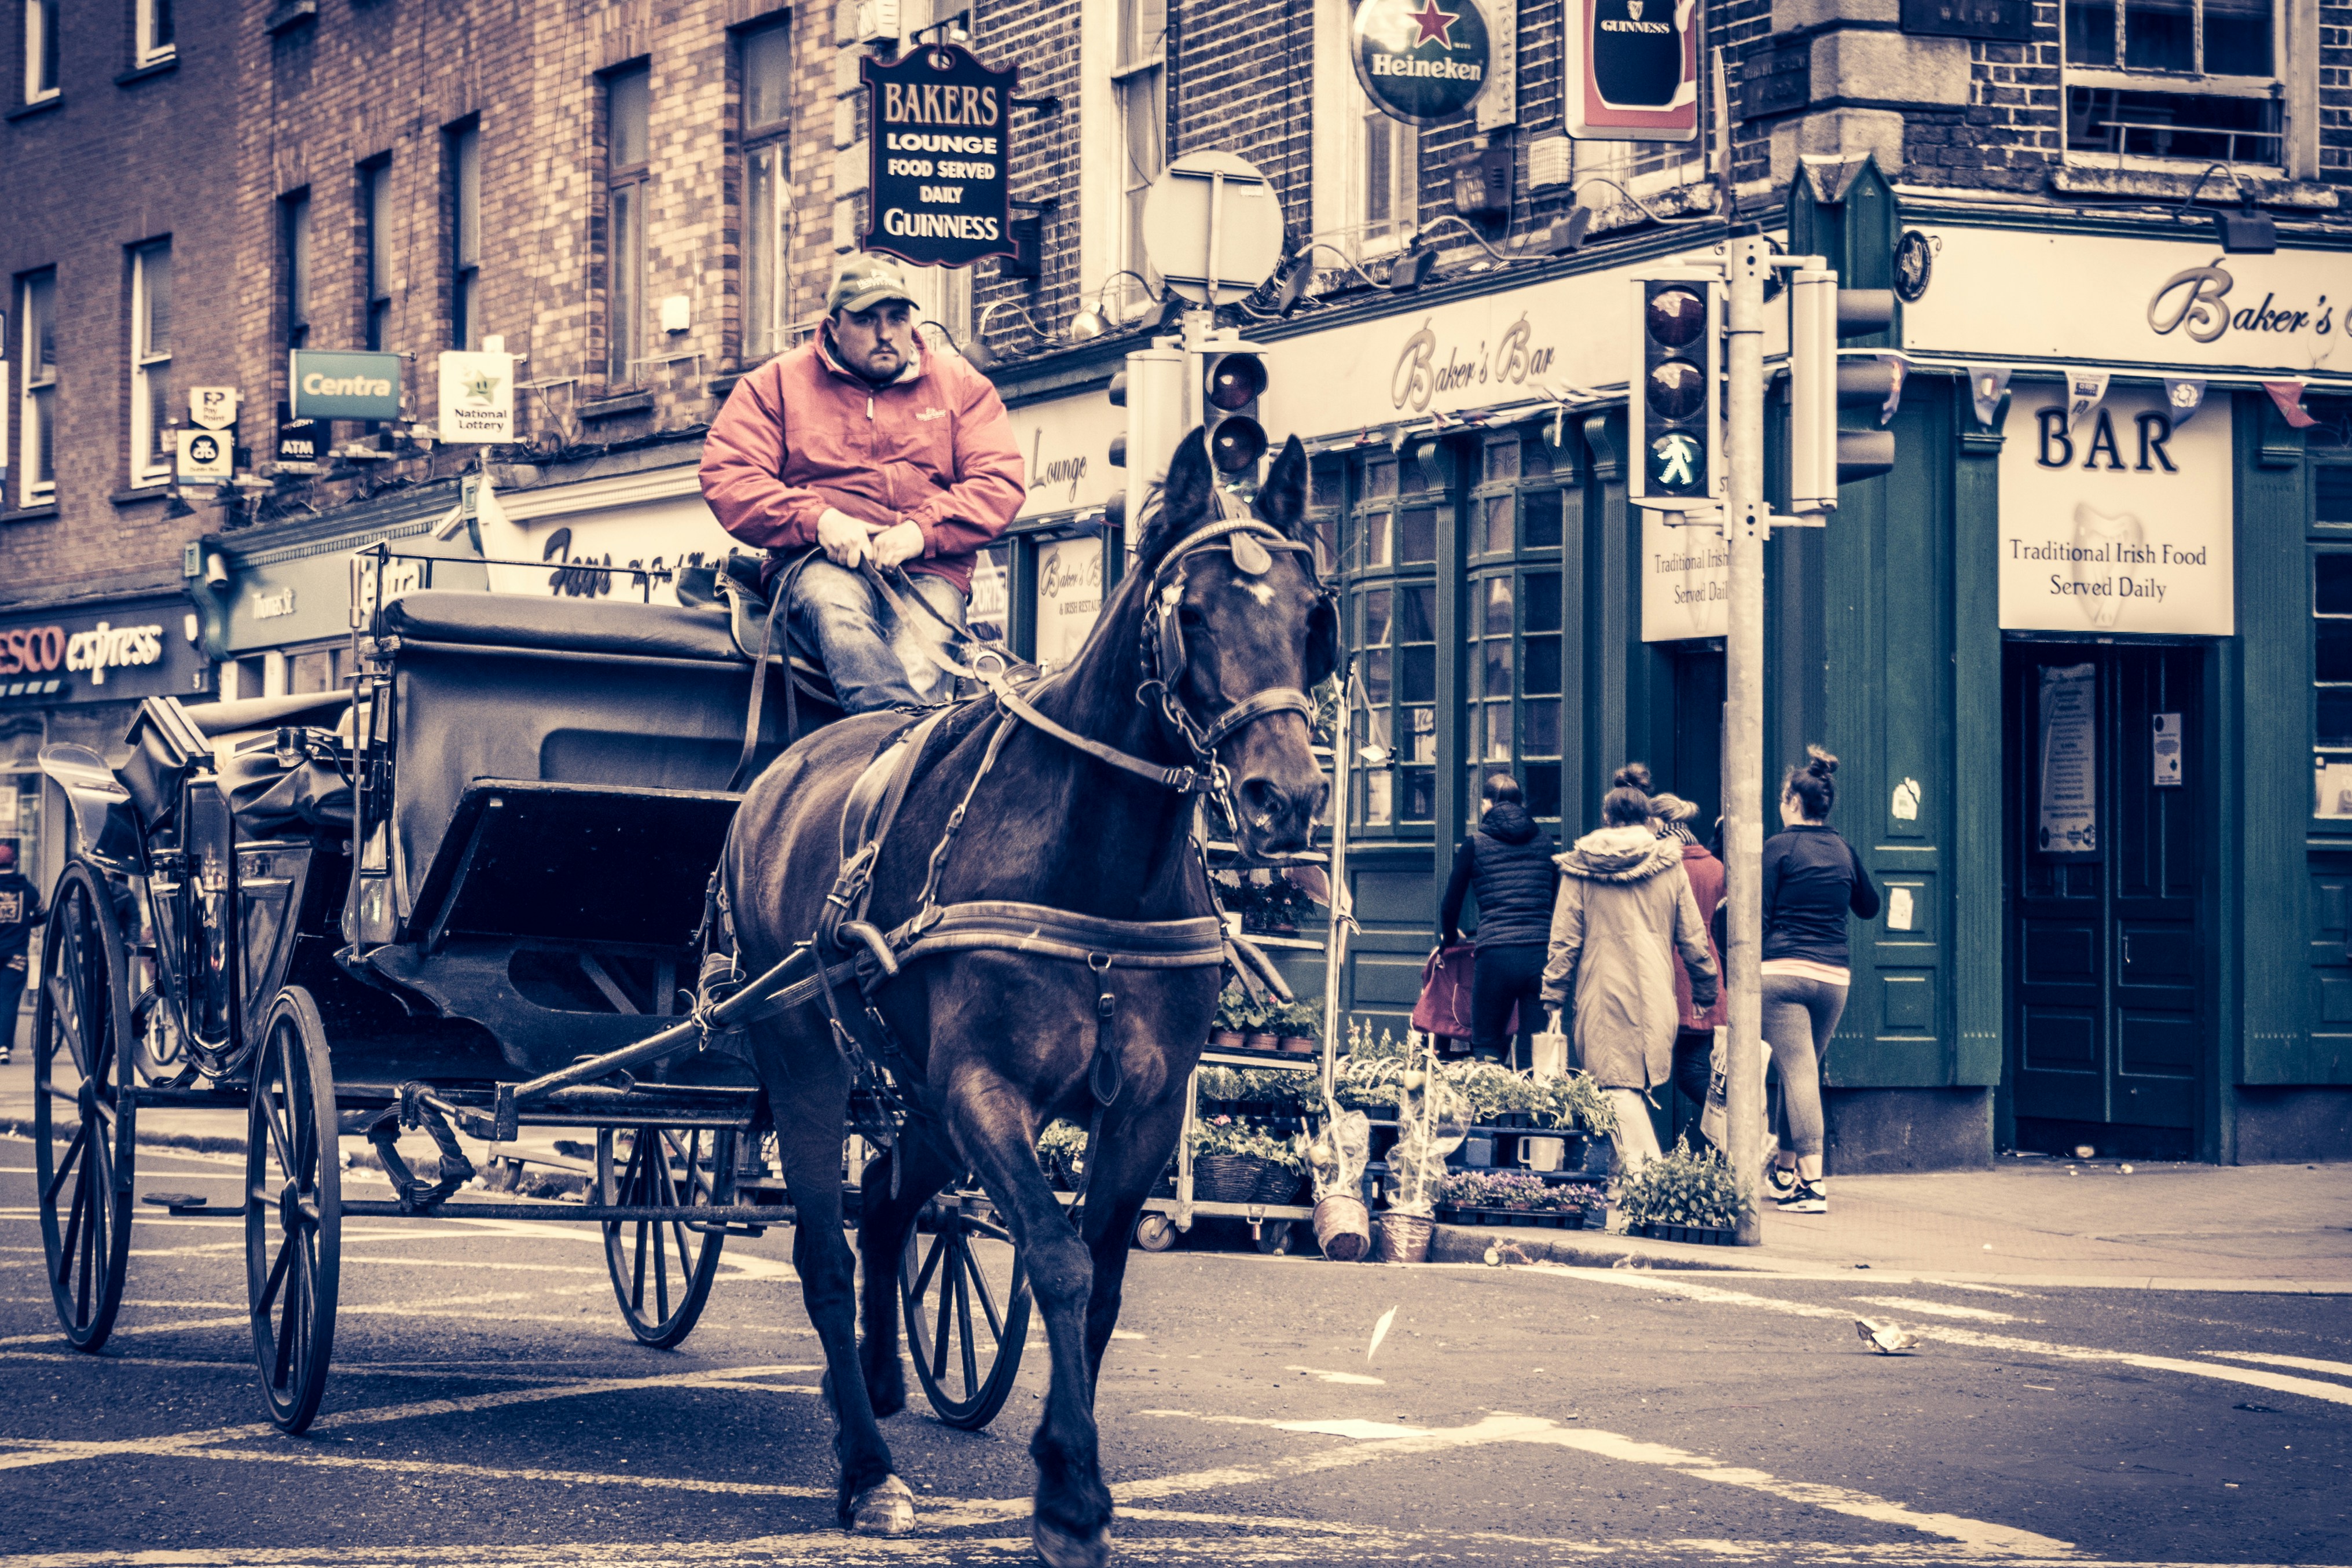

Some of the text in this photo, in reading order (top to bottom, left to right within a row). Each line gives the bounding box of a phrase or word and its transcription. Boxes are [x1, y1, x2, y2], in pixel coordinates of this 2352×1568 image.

[1601, 20, 1670, 34] GUINNESS
[1371, 53, 1481, 81] Heineken
[883, 82, 999, 127] BAKERS
[887, 133, 997, 155] LOUNGE
[888, 159, 995, 179] FOOD SERVED
[920, 185, 963, 203] DAILY
[883, 208, 999, 240] GUINNESS
[2147, 257, 2333, 344] Baker's
[1391, 310, 1555, 413] Baker's Bar
[303, 372, 391, 396] Centra
[455, 409, 507, 418] National
[458, 420, 504, 432] Lottery
[281, 440, 314, 454] ATM
[2035, 405, 2178, 475] BAR
[1028, 426, 1087, 503] Lounge
[1654, 548, 1728, 574] Traditional Irish
[2009, 539, 2207, 565] Traditional Irish Food
[1040, 548, 1084, 598] Baker's
[967, 579, 1006, 614] PORTS
[1675, 581, 1728, 604] Served Dail
[2050, 574, 2167, 603] Served Daily
[252, 593, 282, 619] Thomas
[1059, 603, 1063, 615] &
[1065, 601, 1078, 614] IRISH
[65, 621, 163, 685] express
